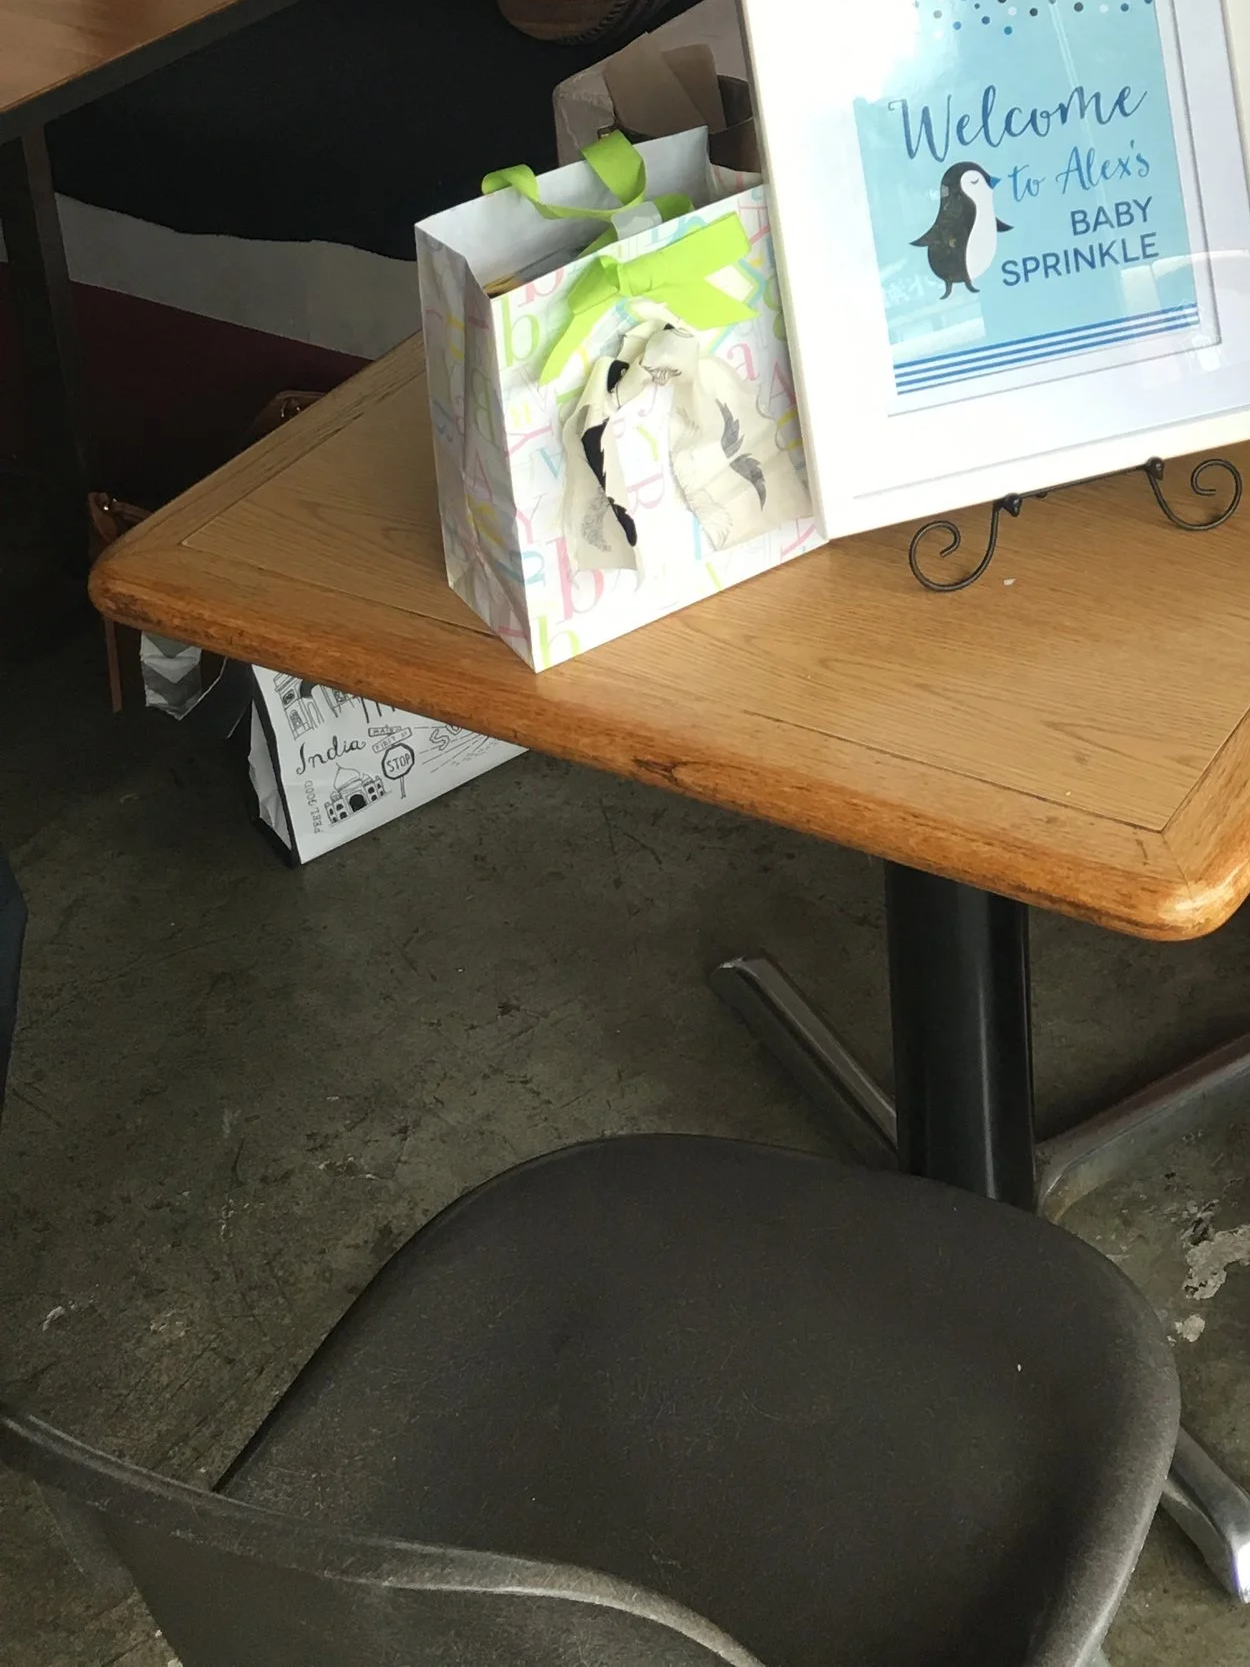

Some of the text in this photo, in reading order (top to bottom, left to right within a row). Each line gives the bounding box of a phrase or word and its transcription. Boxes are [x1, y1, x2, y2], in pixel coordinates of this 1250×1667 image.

[888, 85, 1147, 162] Welcome
[1007, 140, 1150, 202] to Alex's
[1070, 196, 1153, 236] BABY
[1001, 232, 1160, 287] SPRINKLE
[296, 735, 367, 775] India
[386, 752, 412, 773] STOP
